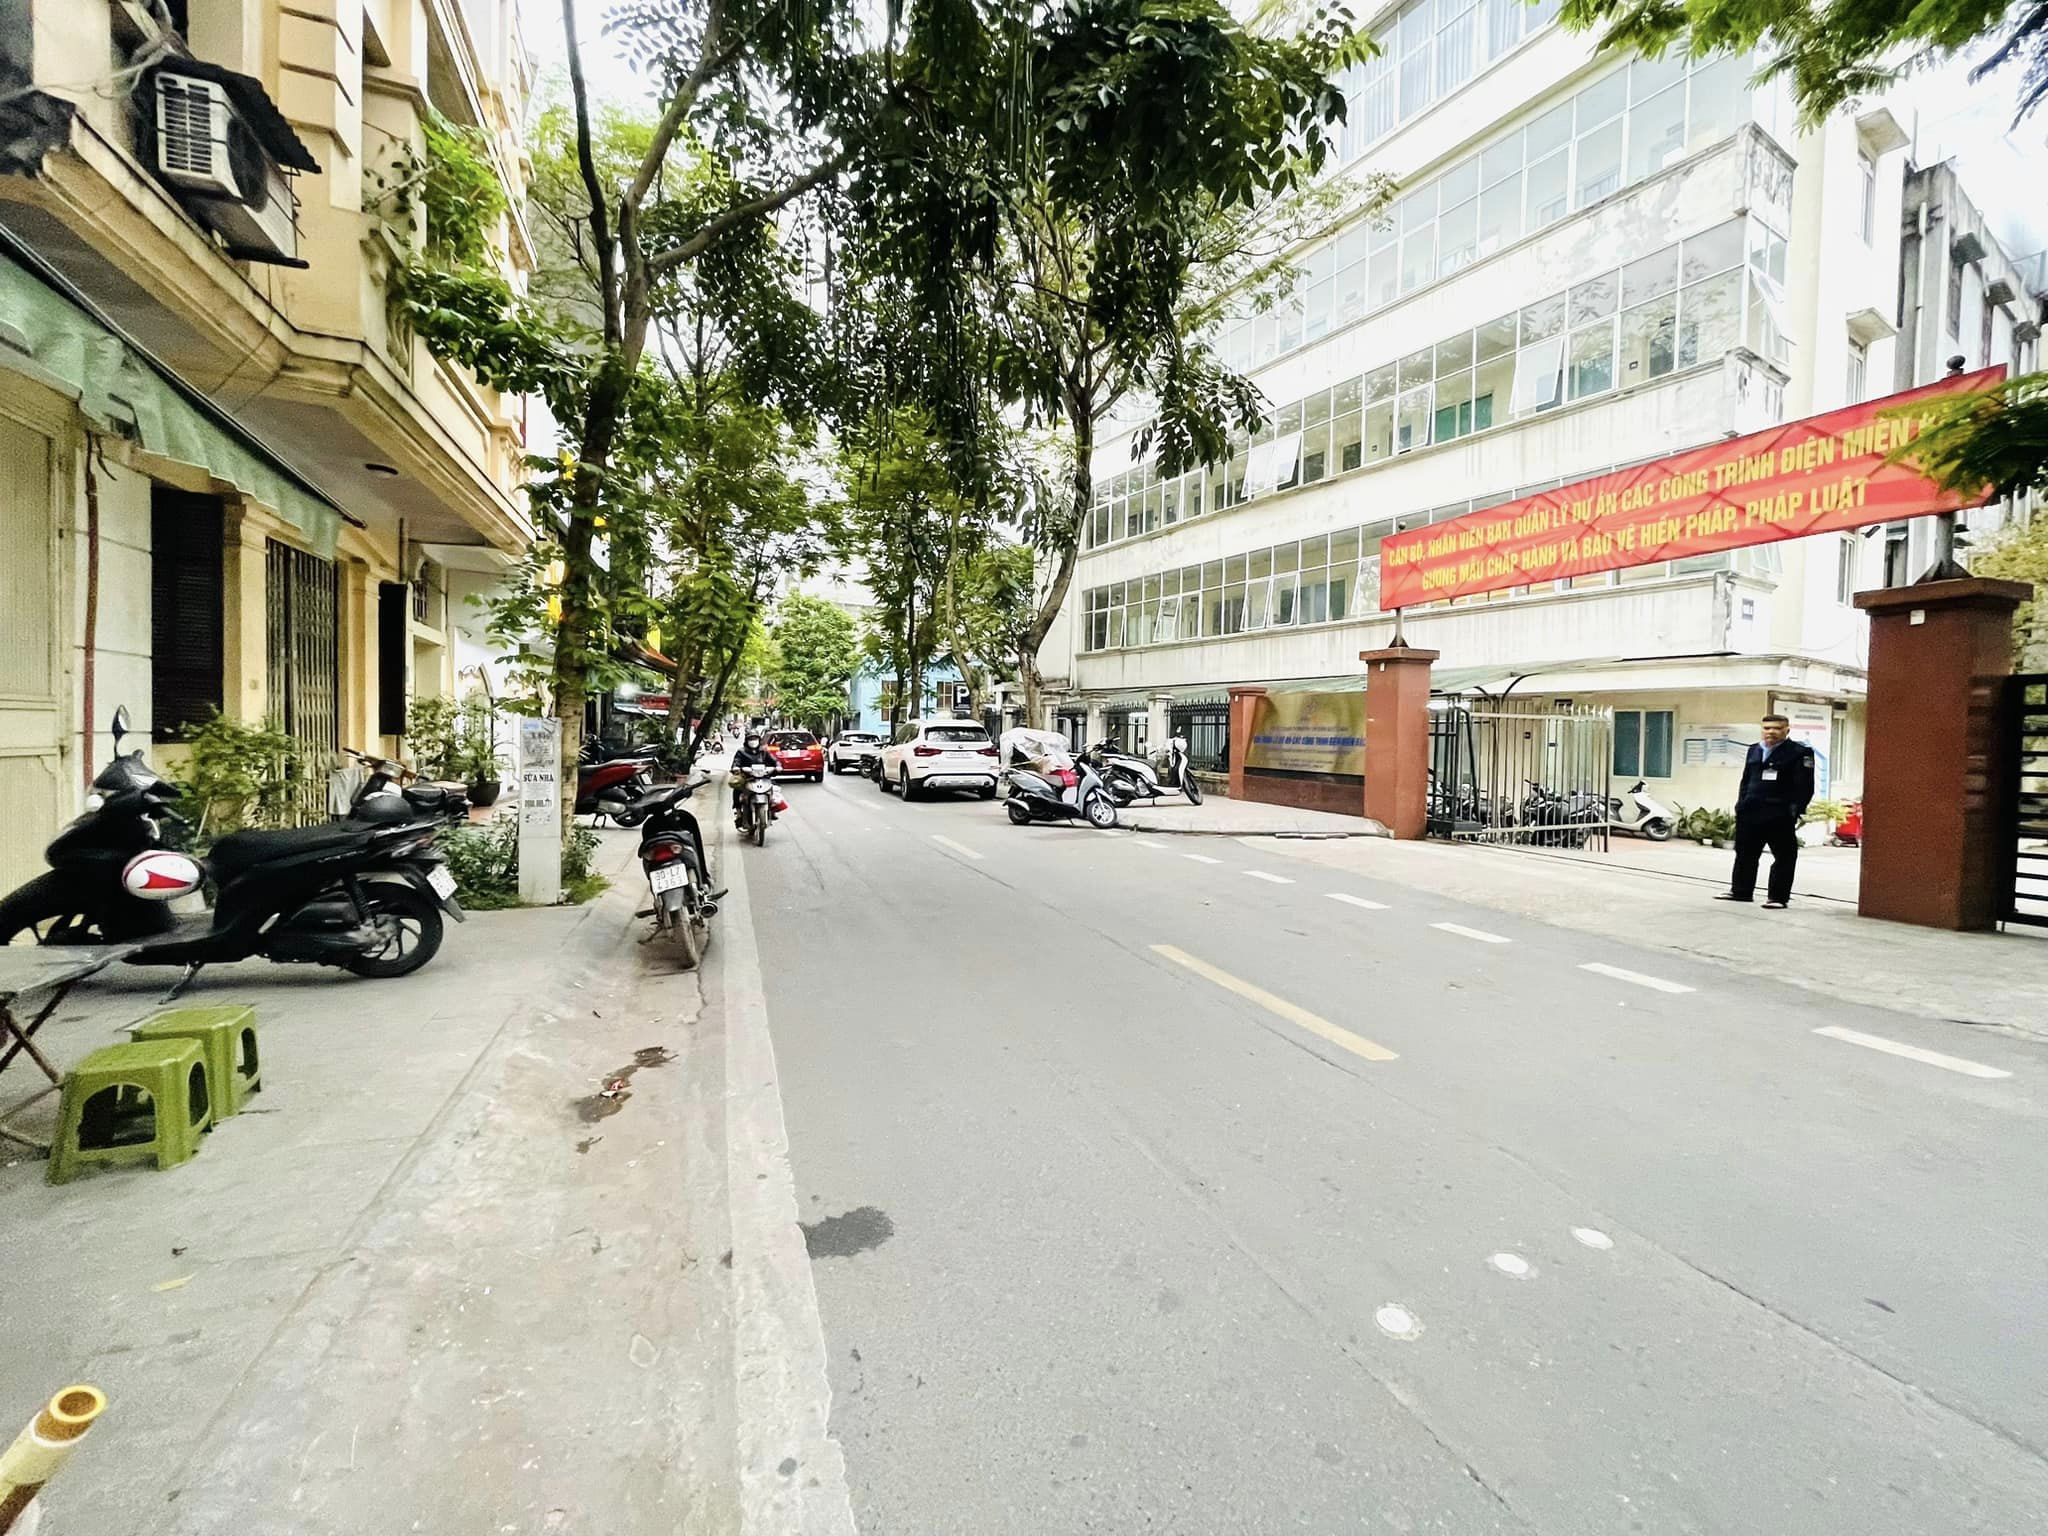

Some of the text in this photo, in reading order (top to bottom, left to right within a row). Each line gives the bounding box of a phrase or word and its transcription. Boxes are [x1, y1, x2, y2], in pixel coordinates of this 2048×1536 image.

[1389, 543, 1408, 567] CÁN
[1429, 533, 1456, 558] NHÂN
[1459, 527, 1484, 549] VIÊN
[1487, 519, 1511, 544] BAN
[1514, 505, 1549, 538] QUẢN
[1553, 501, 1568, 528] LÝ
[1572, 496, 1592, 526] DỰ
[1596, 491, 1617, 518] ÁN
[1621, 482, 1654, 511] CÁC
[1659, 469, 1709, 502] CÔNG
[1714, 452, 1774, 489] TRÌNH
[1780, 436, 1835, 474] ĐIỆN
[1422, 476, 1868, 590] GƯƠNG MẪU CHẤP HÀNH VÀ BẢO VỆ HIẾN PHÁP, PHÁP LUẬT
[957, 686, 970, 703] P
